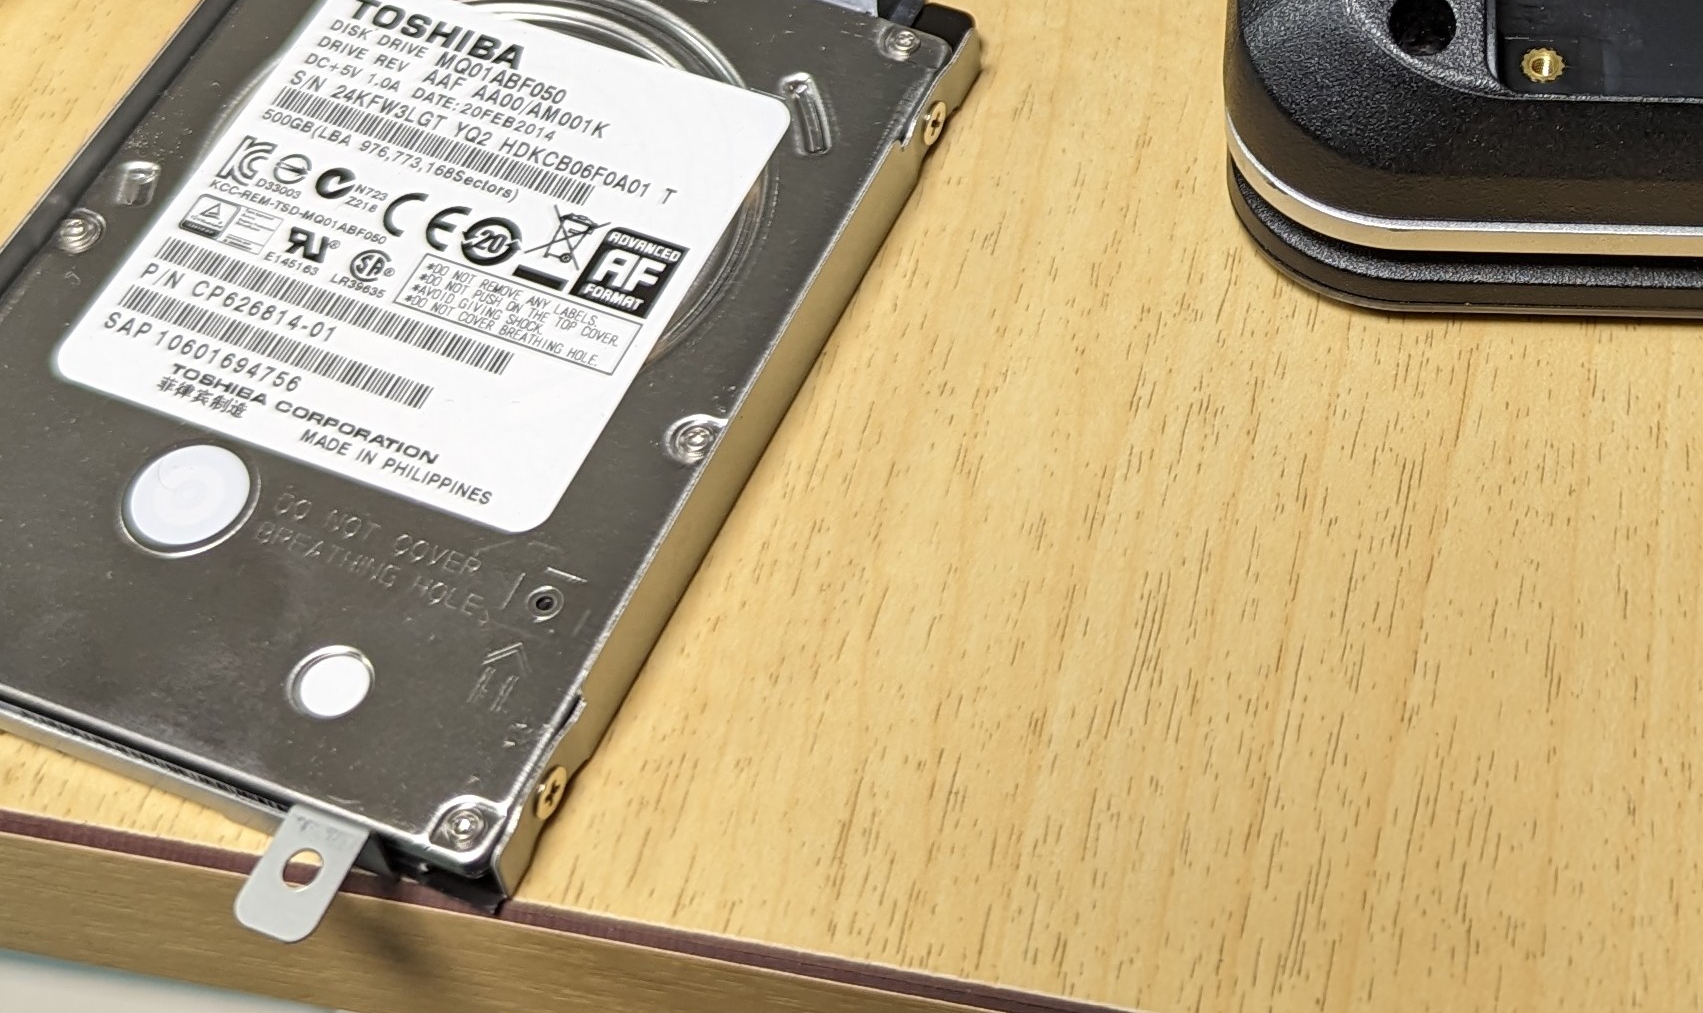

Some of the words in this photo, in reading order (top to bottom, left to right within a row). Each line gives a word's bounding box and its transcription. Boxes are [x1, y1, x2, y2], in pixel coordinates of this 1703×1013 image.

[304, 52, 363, 79] DC+5V
[369, 73, 402, 93] 1.0A
[317, 35, 369, 61] DRIVE
[374, 53, 411, 73] REV
[423, 69, 467, 92] AAF
[471, 85, 611, 138] AA00/AM001K
[330, 18, 374, 41] DISK
[377, 34, 429, 59] DRIVE
[434, 51, 567, 104] MQ01ABF050
[261, 108, 351, 147] 500GB(LBA
[290, 69, 328, 93] S/N
[330, 84, 449, 131] 24KFW3LGT
[453, 121, 494, 147] YQ2
[661, 187, 678, 205] T
[209, 179, 387, 245] KCC-REM-TSD-MQ01ABF050
[255, 178, 303, 200] D33003
[354, 183, 389, 202] N723
[264, 251, 320, 277] E145163
[590, 248, 667, 293] AF
[606, 230, 684, 263] ADVANCED
[140, 262, 186, 289] P/N
[191, 279, 338, 342] CP626814-01
[330, 273, 387, 299] LR39635
[446, 278, 469, 294] NOT
[472, 287, 502, 307] PUSH
[505, 299, 523, 314] ON
[526, 305, 549, 322] THE
[555, 314, 578, 330] TOP
[580, 324, 620, 348] COVER.
[453, 267, 477, 283] NOT
[479, 275, 525, 301] REMOVE
[525, 291, 552, 309] ANY
[554, 300, 599, 328] LABELS.
[458, 295, 503, 321] GIVING
[579, 283, 644, 312] FORMAT
[103, 311, 153, 339] SAP
[154, 330, 303, 393] 10601694756
[431, 300, 454, 317] NOT
[457, 310, 496, 333] COVER
[498, 324, 564, 359] BREATHING
[566, 345, 600, 368] HOLE.
[172, 362, 268, 406] TOSHIBA
[275, 399, 440, 466] CORPORATION
[299, 428, 353, 457] MADE
[355, 447, 378, 467] IN
[381, 456, 493, 507] PHILIPPINES
[272, 491, 312, 521] DO
[324, 508, 382, 539] NOT
[391, 534, 483, 576] COVER
